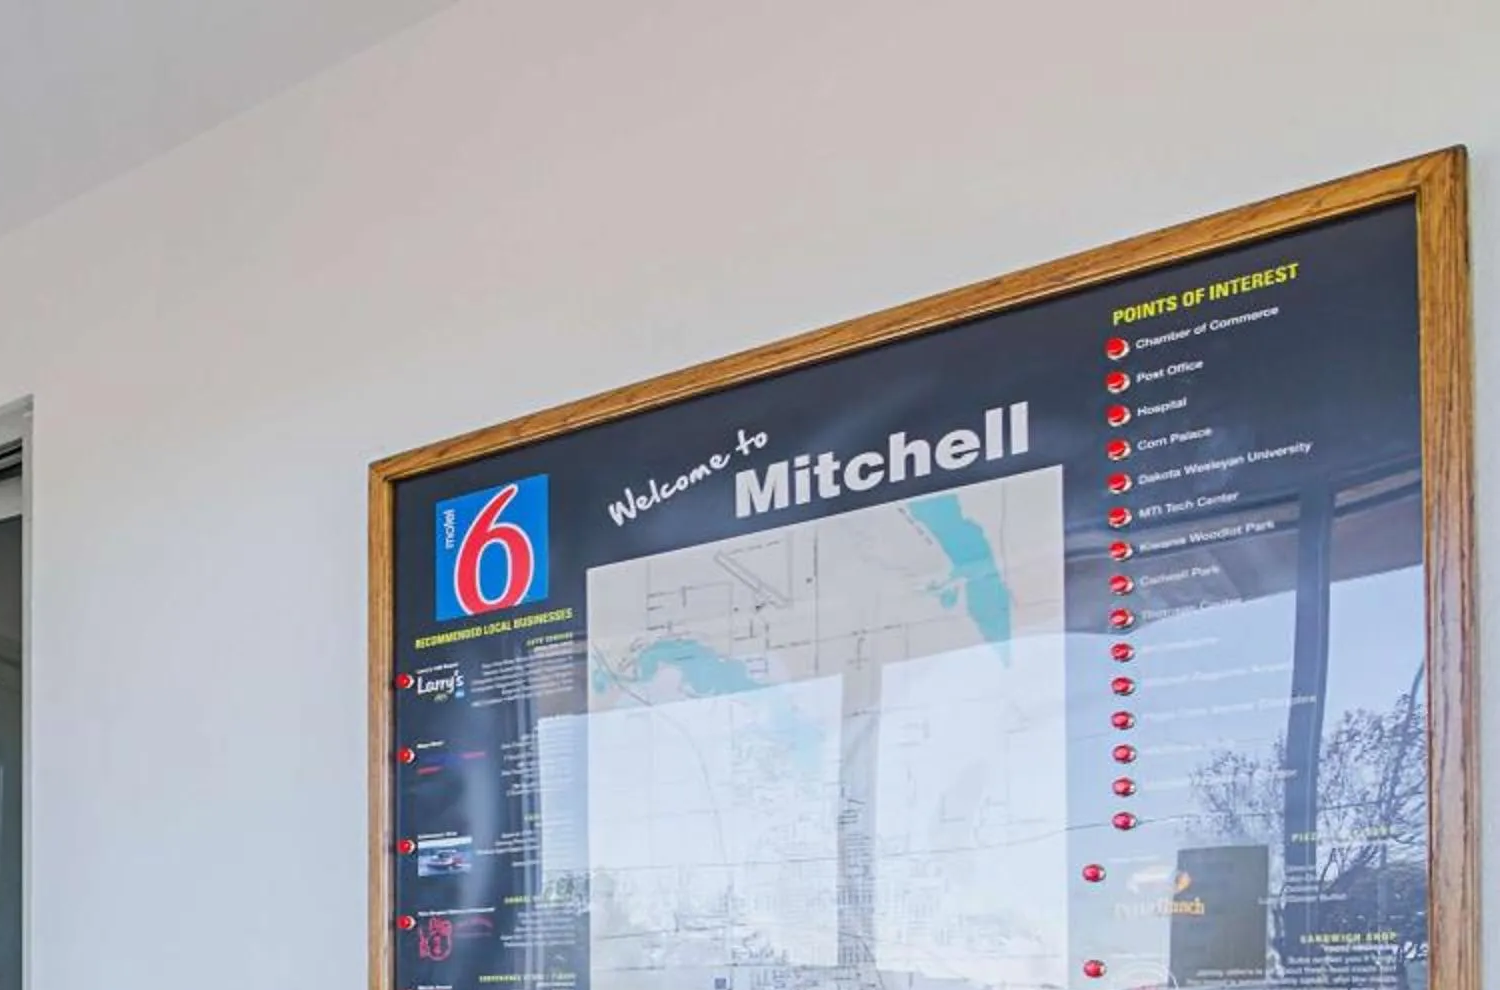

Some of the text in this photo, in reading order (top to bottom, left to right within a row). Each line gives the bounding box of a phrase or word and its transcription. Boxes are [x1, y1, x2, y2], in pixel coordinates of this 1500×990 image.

[1112, 263, 1300, 326] POINTS OF INTEREST
[1135, 306, 1280, 350] Chamber of Commerce
[1136, 360, 1204, 383] Post Office
[1137, 397, 1187, 417] Hospital
[1170, 427, 1213, 444] Palace
[608, 428, 768, 527] Welcome to
[734, 401, 1030, 520] Mitchell
[1138, 440, 1314, 486] Dakota Wesleyan University
[1166, 500, 1194, 514] Tech
[1197, 491, 1240, 507] Center
[443, 508, 456, 550] motel
[1245, 520, 1275, 533] Park
[453, 483, 535, 616] 6
[414, 608, 574, 650] RECOMMENDED LOCAL BUSINESSES
